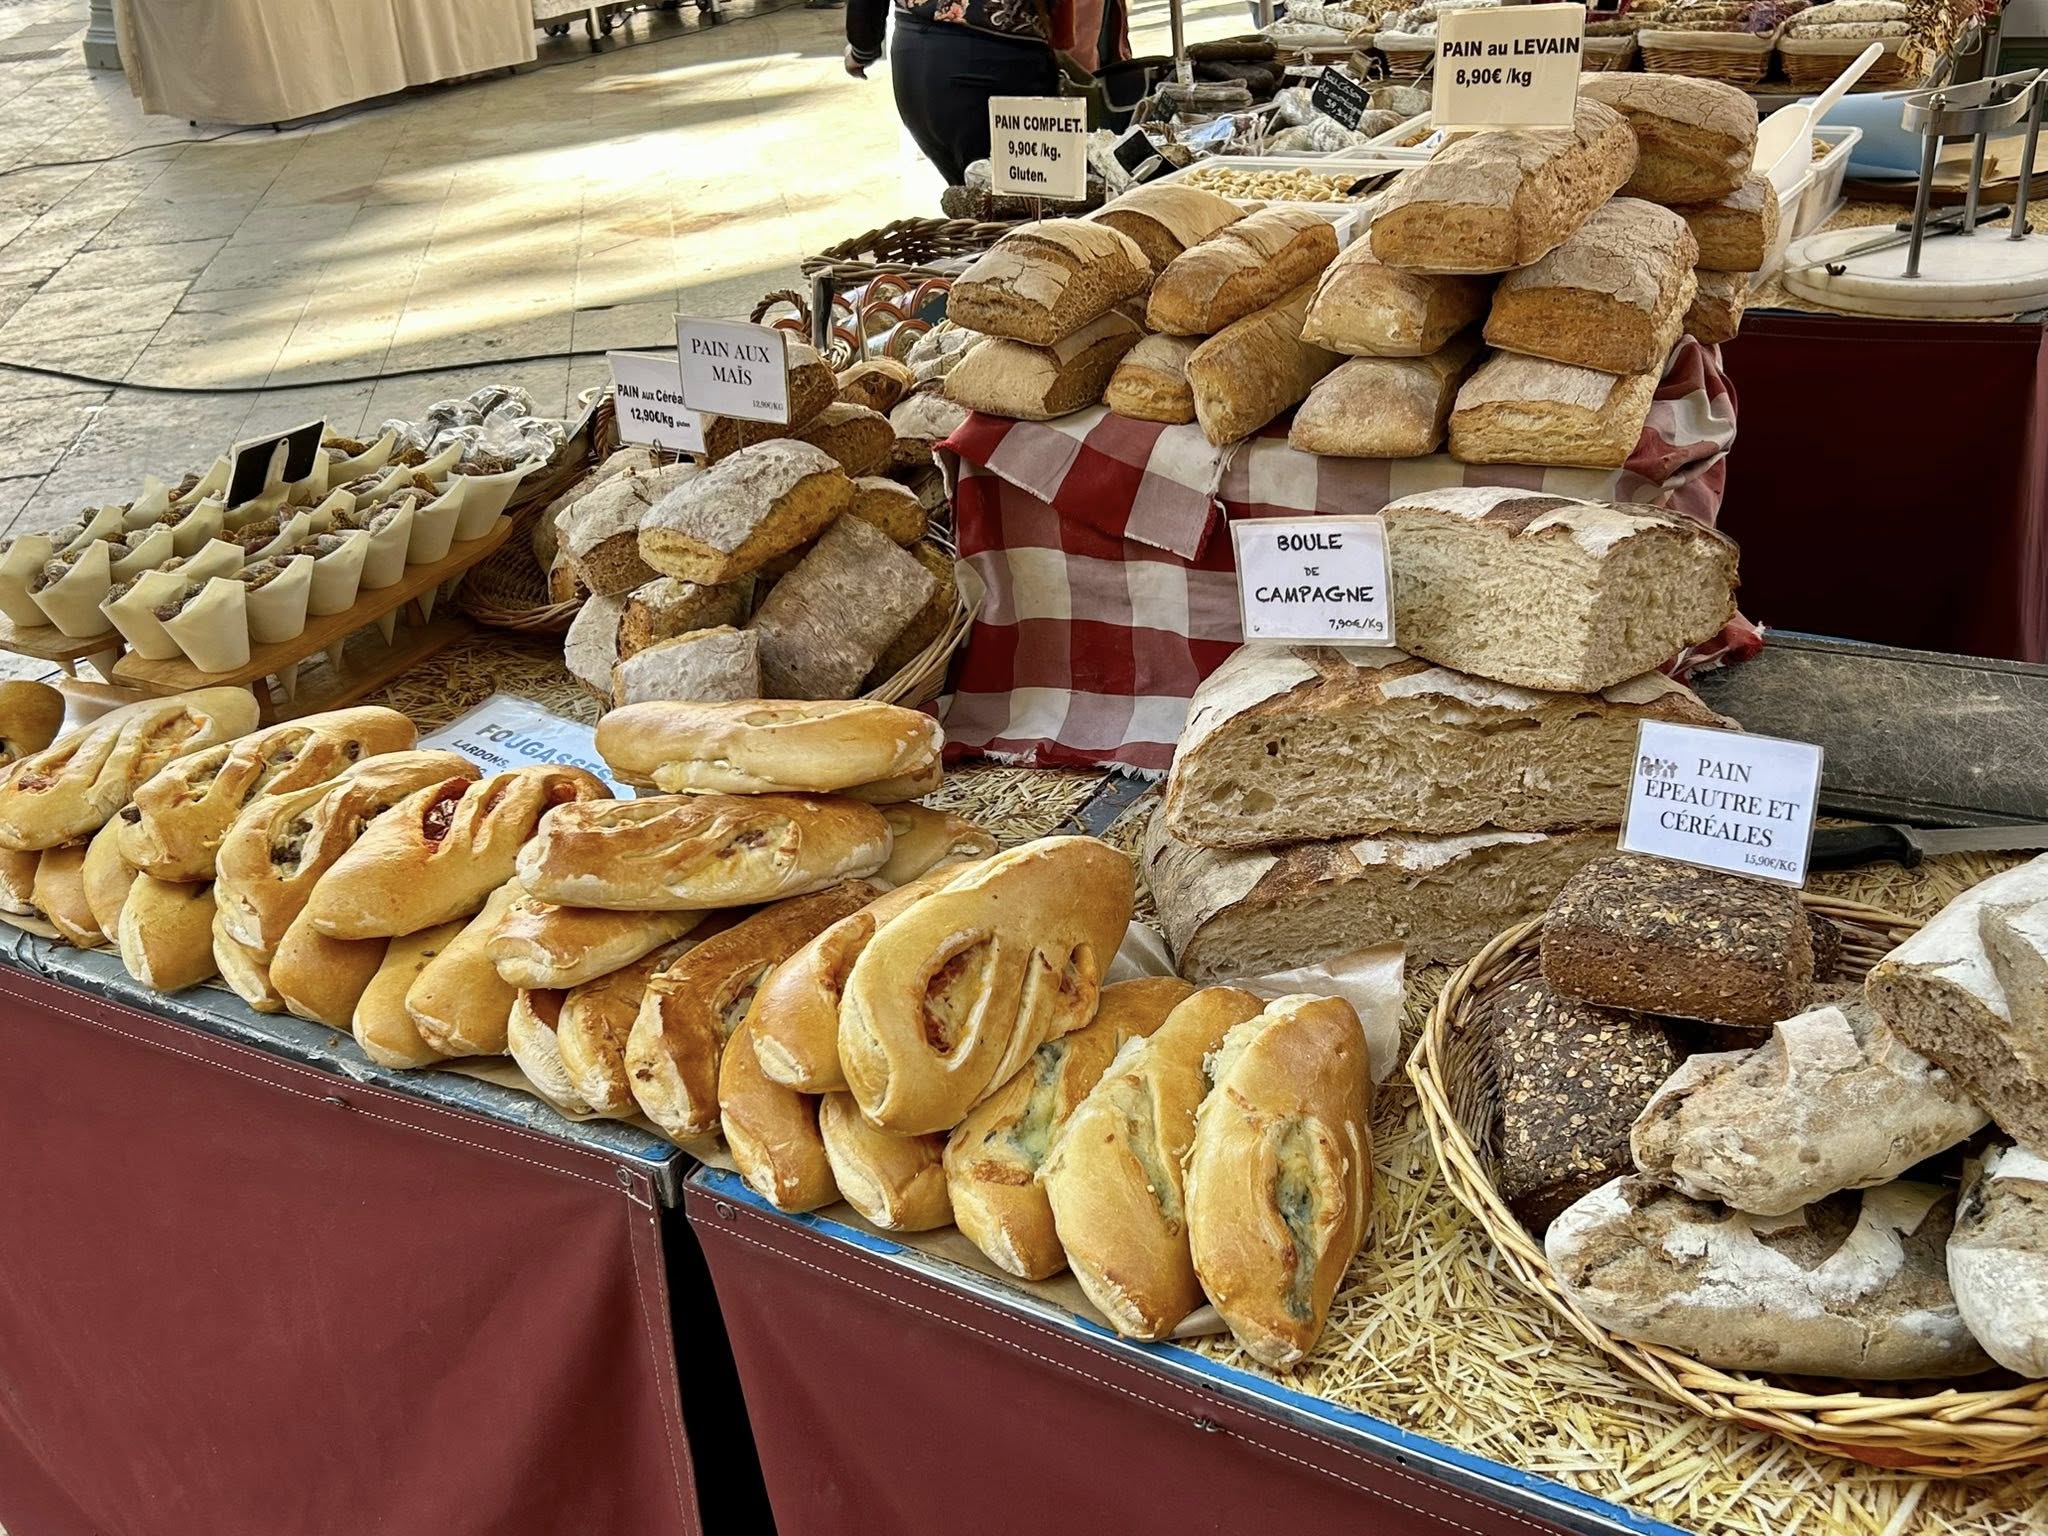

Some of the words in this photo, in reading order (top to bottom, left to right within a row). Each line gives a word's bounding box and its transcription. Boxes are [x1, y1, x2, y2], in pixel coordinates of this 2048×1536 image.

[1443, 41, 1482, 57] PAIN
[1487, 43, 1508, 56] au
[1513, 37, 1580, 55] LEVAIN
[1456, 68, 1502, 88] 8,90€
[1505, 68, 1532, 87] /kg
[995, 115, 1020, 130] PAIN
[1023, 116, 1083, 133] COMPLET.
[1008, 140, 1038, 158] 9,90€
[1040, 143, 1061, 161] /kg.
[1009, 165, 1047, 183] Gluten.
[691, 338, 729, 358] PAIN
[734, 345, 770, 363] AUX
[712, 365, 752, 386] MAÏS
[617, 384, 639, 399] PAIN
[642, 391, 655, 400] AUX
[656, 389, 684, 405] Céréa
[630, 407, 674, 428] 12,90€/kg
[1277, 533, 1343, 551] BOULE
[1304, 566, 1320, 577] DE
[1255, 586, 1374, 603] CAMPAGNE
[1639, 755, 1678, 778] Petit
[1696, 758, 1752, 784] PAIN
[1645, 776, 1762, 816] ÉPEAUTRE
[1767, 799, 1800, 822] ET
[1660, 809, 1774, 848] CÉRÉALES
[1744, 853, 1798, 872] 15,90€/KG
